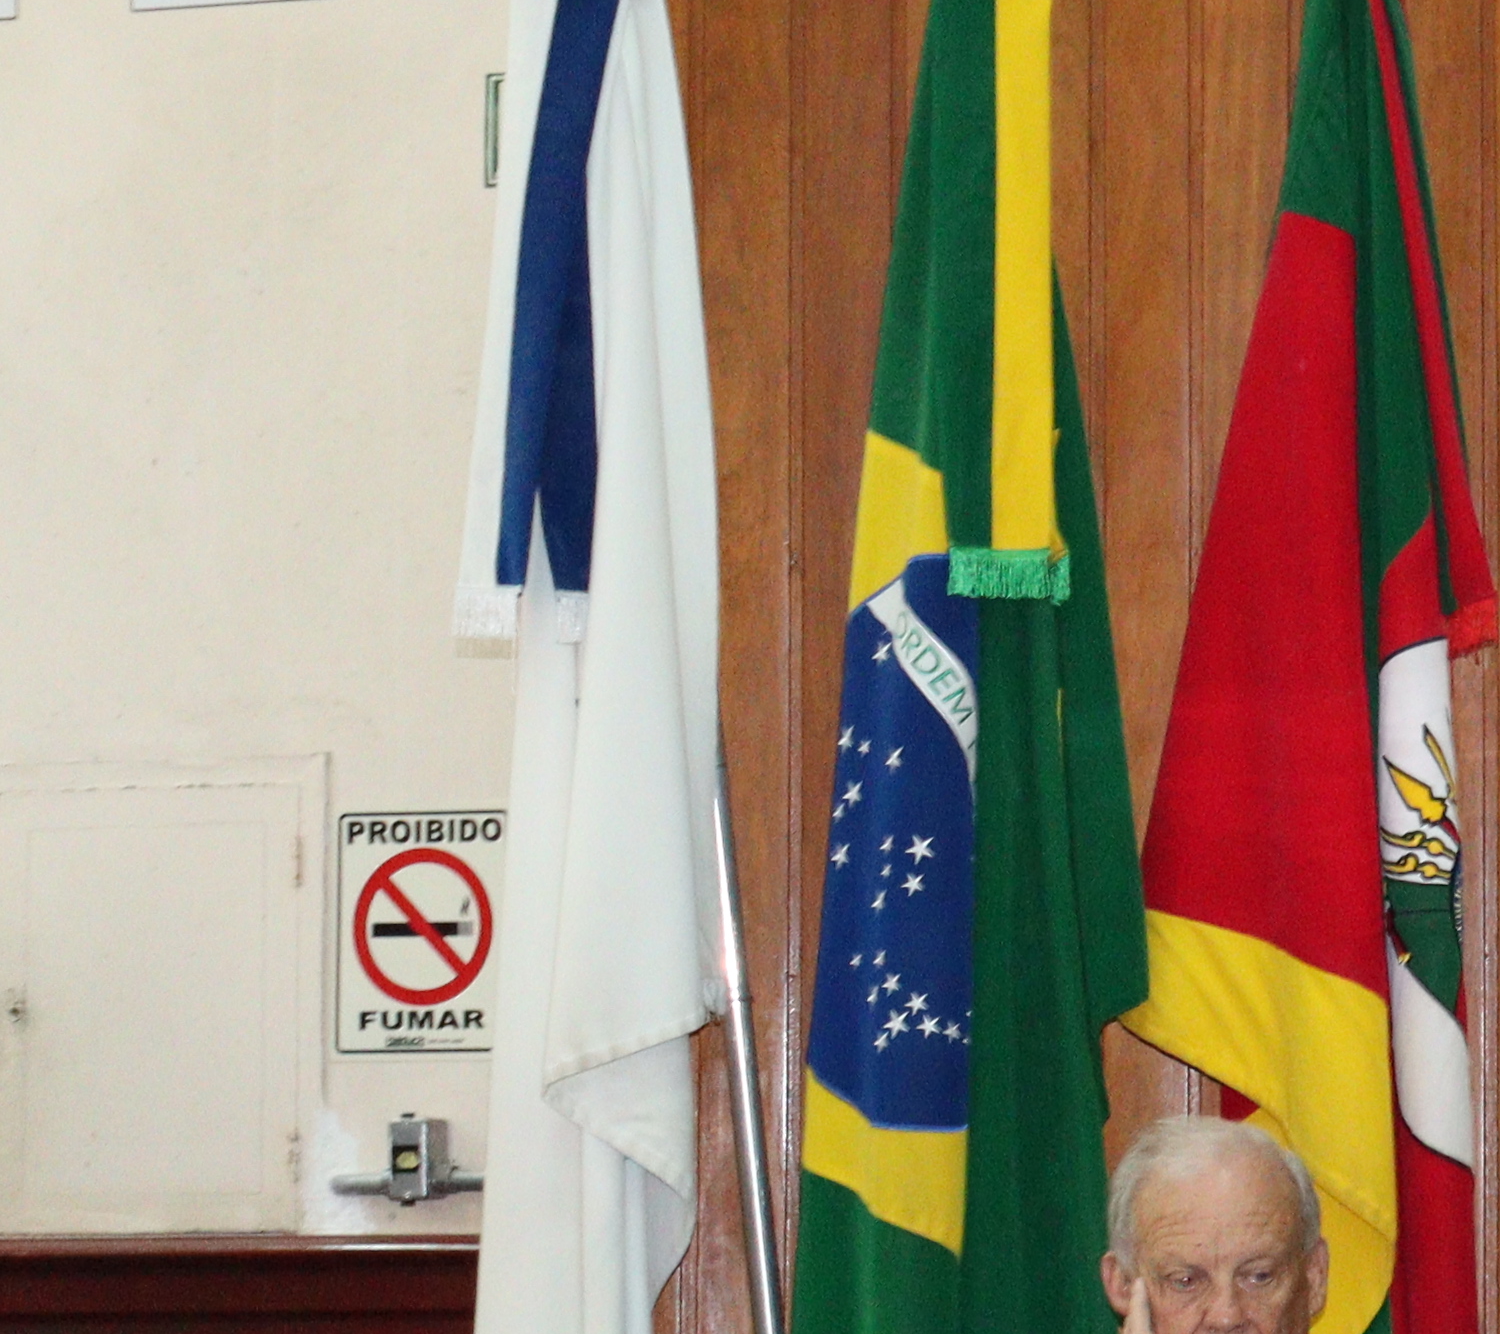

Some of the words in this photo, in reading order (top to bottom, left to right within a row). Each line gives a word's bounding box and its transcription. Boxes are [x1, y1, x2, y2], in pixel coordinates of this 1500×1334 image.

[895, 610, 975, 725] ORDEM
[347, 818, 502, 844] PROIBIDO
[358, 1009, 485, 1031] FUMAR
